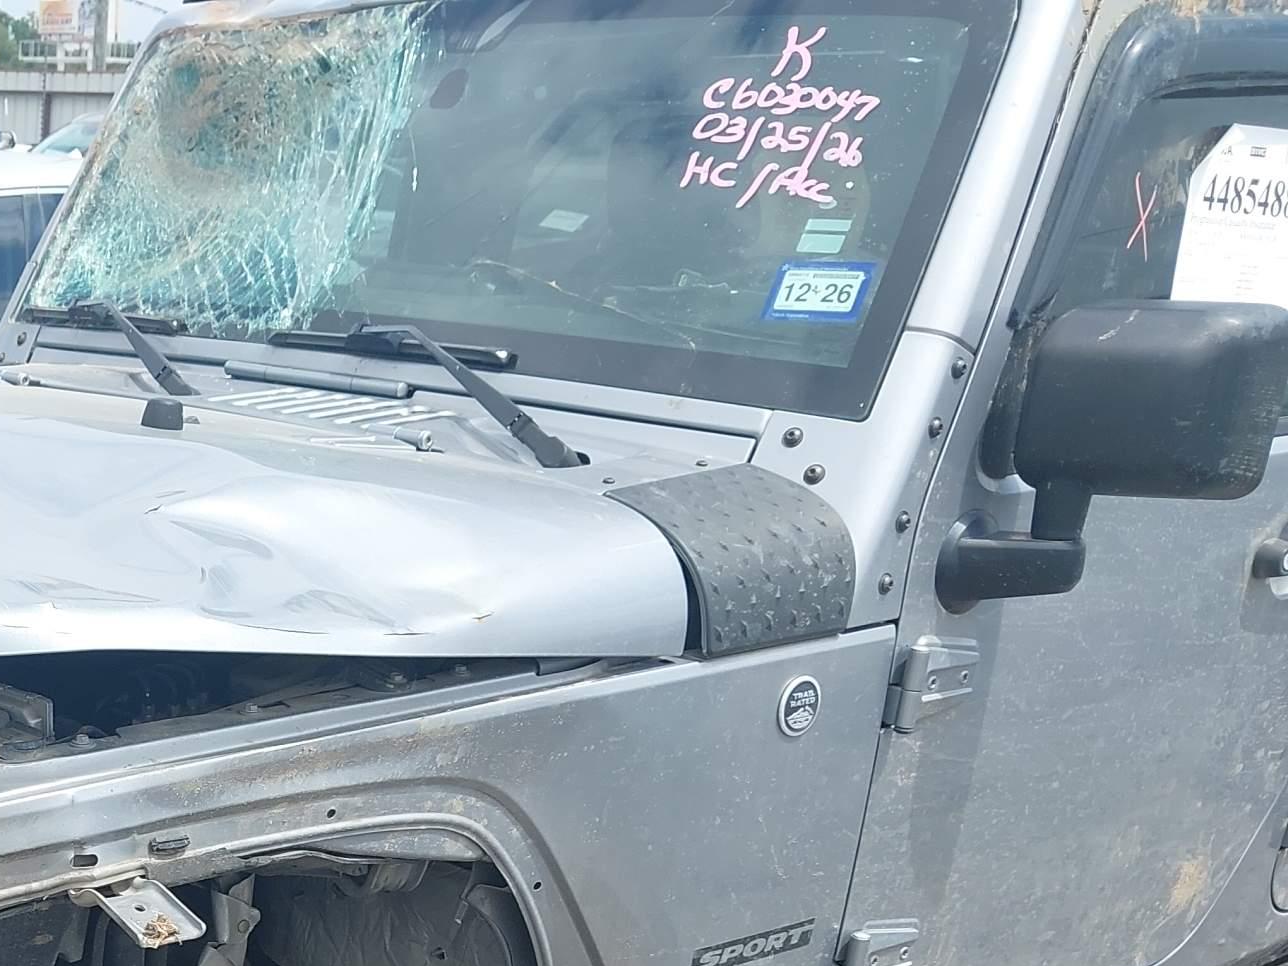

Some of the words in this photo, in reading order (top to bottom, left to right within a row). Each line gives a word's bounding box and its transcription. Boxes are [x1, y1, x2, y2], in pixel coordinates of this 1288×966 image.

[692, 112, 863, 174] 03/25/26
[783, 282, 812, 302] 12
[819, 283, 854, 304] 26
[790, 697, 816, 708] RATED
[791, 689, 816, 700] TRAIL
[695, 922, 816, 966] SPORT
